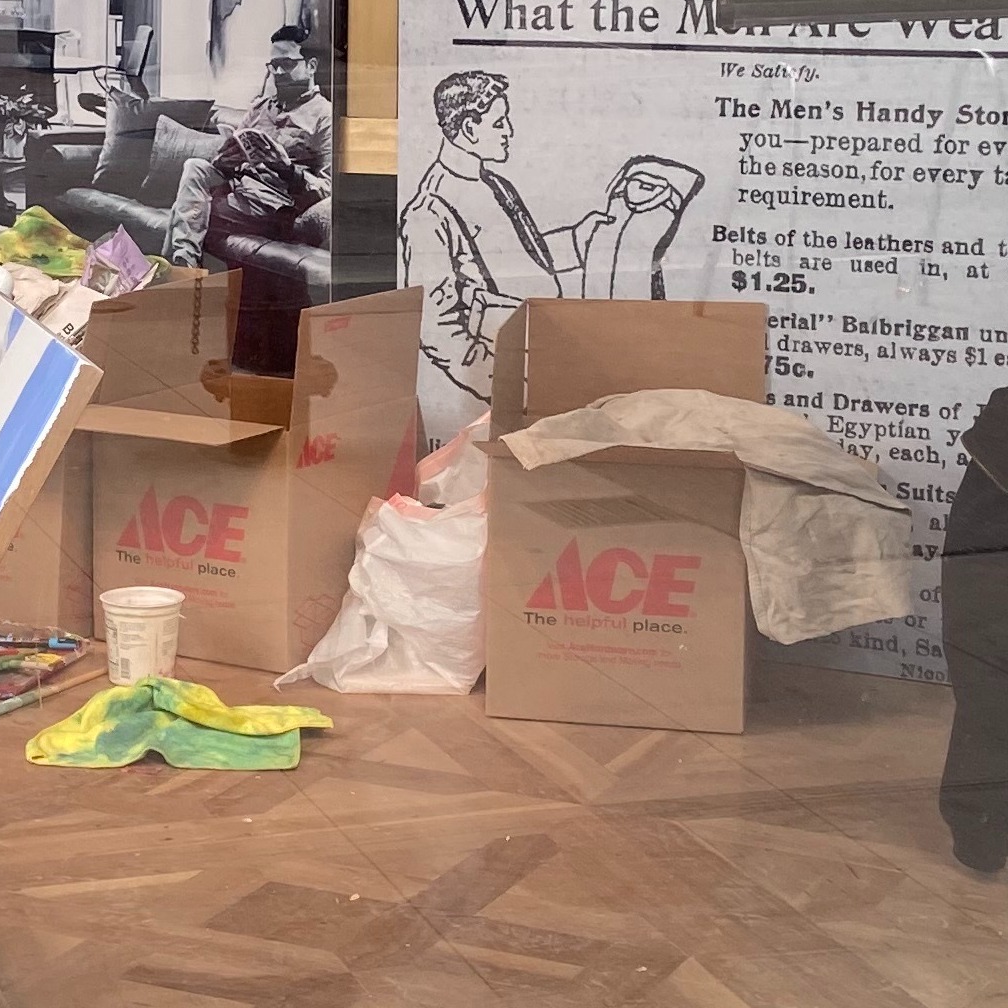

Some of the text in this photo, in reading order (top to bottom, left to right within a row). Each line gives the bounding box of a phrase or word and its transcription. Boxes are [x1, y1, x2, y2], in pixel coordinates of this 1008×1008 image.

[720, 62, 820, 82] We Satisfy.
[715, 97, 761, 118] The
[770, 99, 844, 121] Men's
[856, 101, 944, 129] Handy
[933, 134, 970, 155] for
[738, 155, 776, 176] the
[782, 162, 867, 182] season,
[869, 160, 904, 181] for
[913, 167, 985, 190] every
[737, 186, 894, 210] requirement.
[712, 224, 767, 245] Belts
[774, 230, 797, 247] of
[803, 229, 838, 249] the
[845, 231, 934, 253] leathers
[942, 238, 985, 256] and
[732, 248, 990, 281] belts are used in, at
[731, 271, 816, 294] $1.25.
[842, 315, 969, 342] Balbriggan
[777, 333, 869, 362] drawers,
[877, 341, 957, 367] always
[965, 346, 988, 367] $1
[784, 392, 823, 409] and
[833, 393, 930, 418] Drawers
[939, 403, 962, 420] of
[827, 415, 931, 441] Egyptian
[296, 433, 339, 469] ACE
[889, 446, 946, 469] each,
[116, 486, 249, 563] ACE
[116, 550, 141, 564] The
[146, 553, 192, 570] helpful
[526, 535, 702, 617] ACE
[523, 612, 688, 634] The helpful place.
[904, 614, 928, 629] or
[849, 631, 907, 658] kind,
